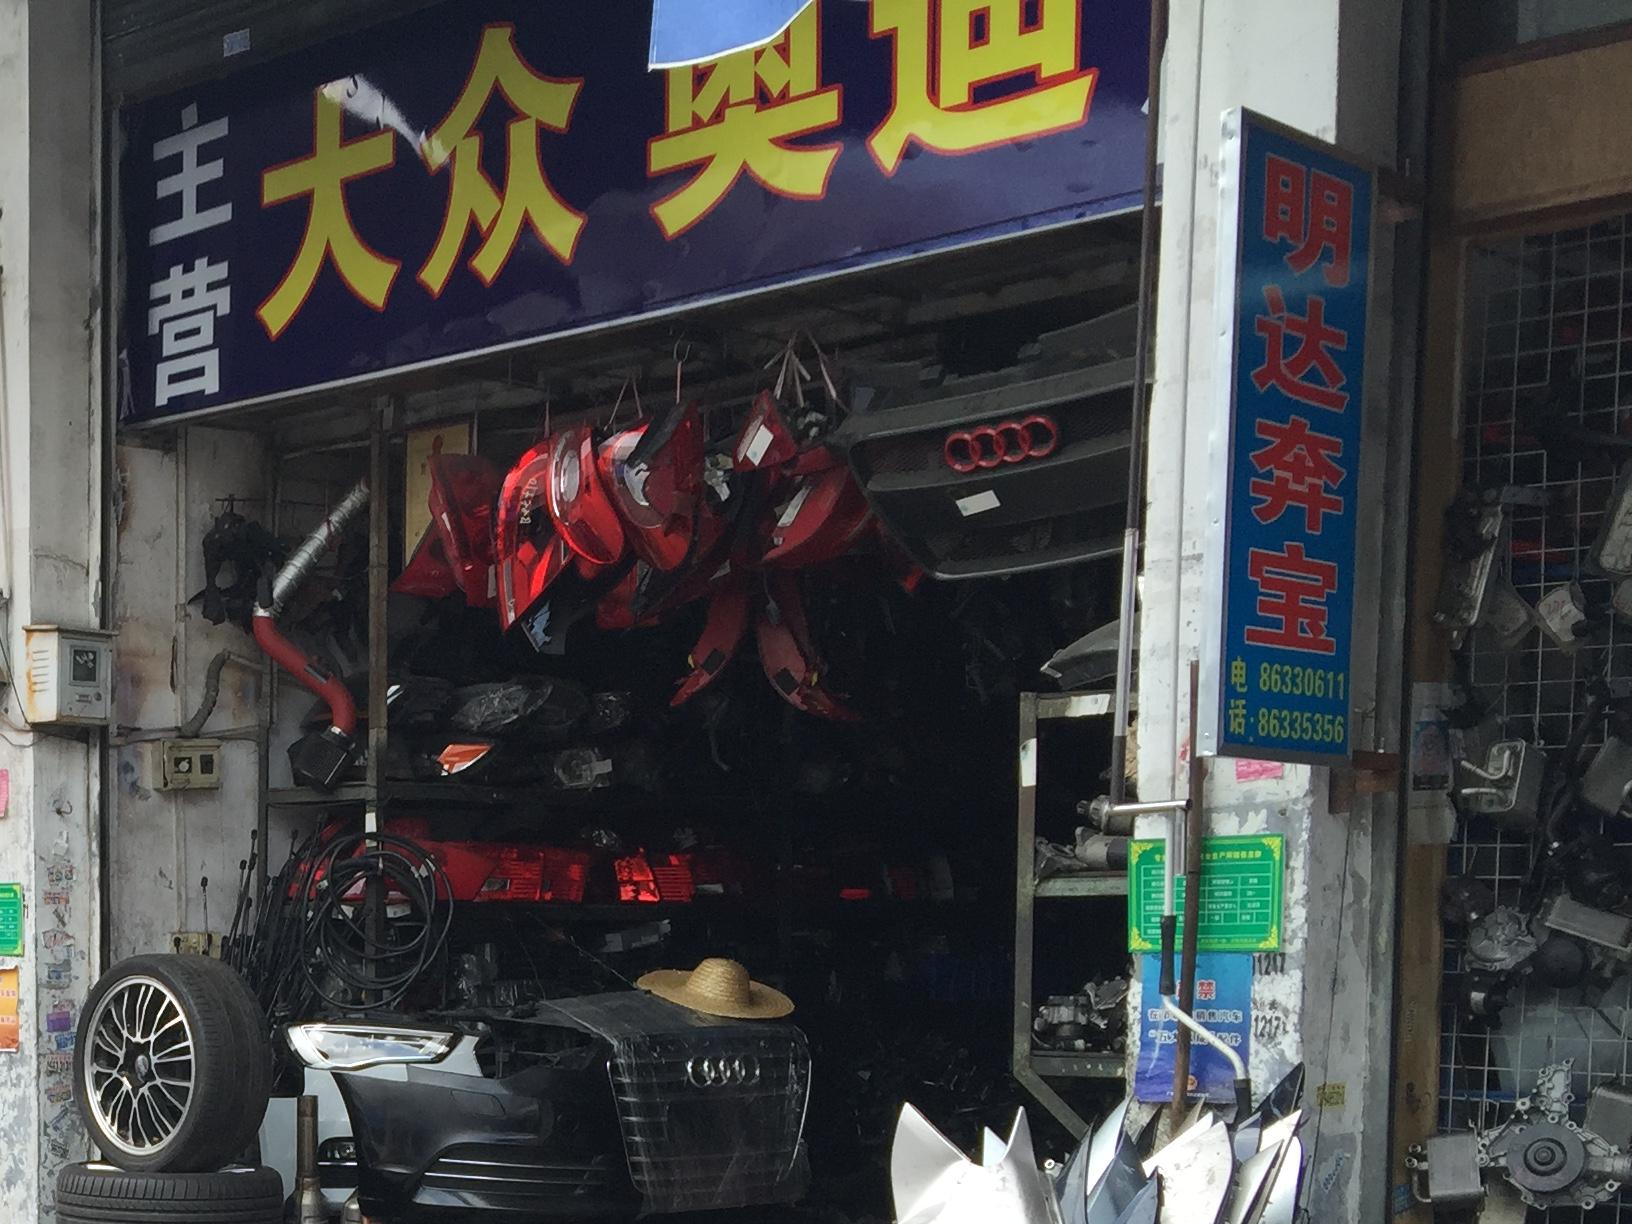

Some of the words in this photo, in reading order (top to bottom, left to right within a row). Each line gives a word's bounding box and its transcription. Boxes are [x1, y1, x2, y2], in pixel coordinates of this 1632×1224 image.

[148, 103, 231, 406] 主营
[254, 21, 585, 342] 大众
[1244, 154, 1355, 656] 明达奔宝
[1258, 699, 1344, 745] 86335356
[1259, 651, 1346, 701] 86330611
